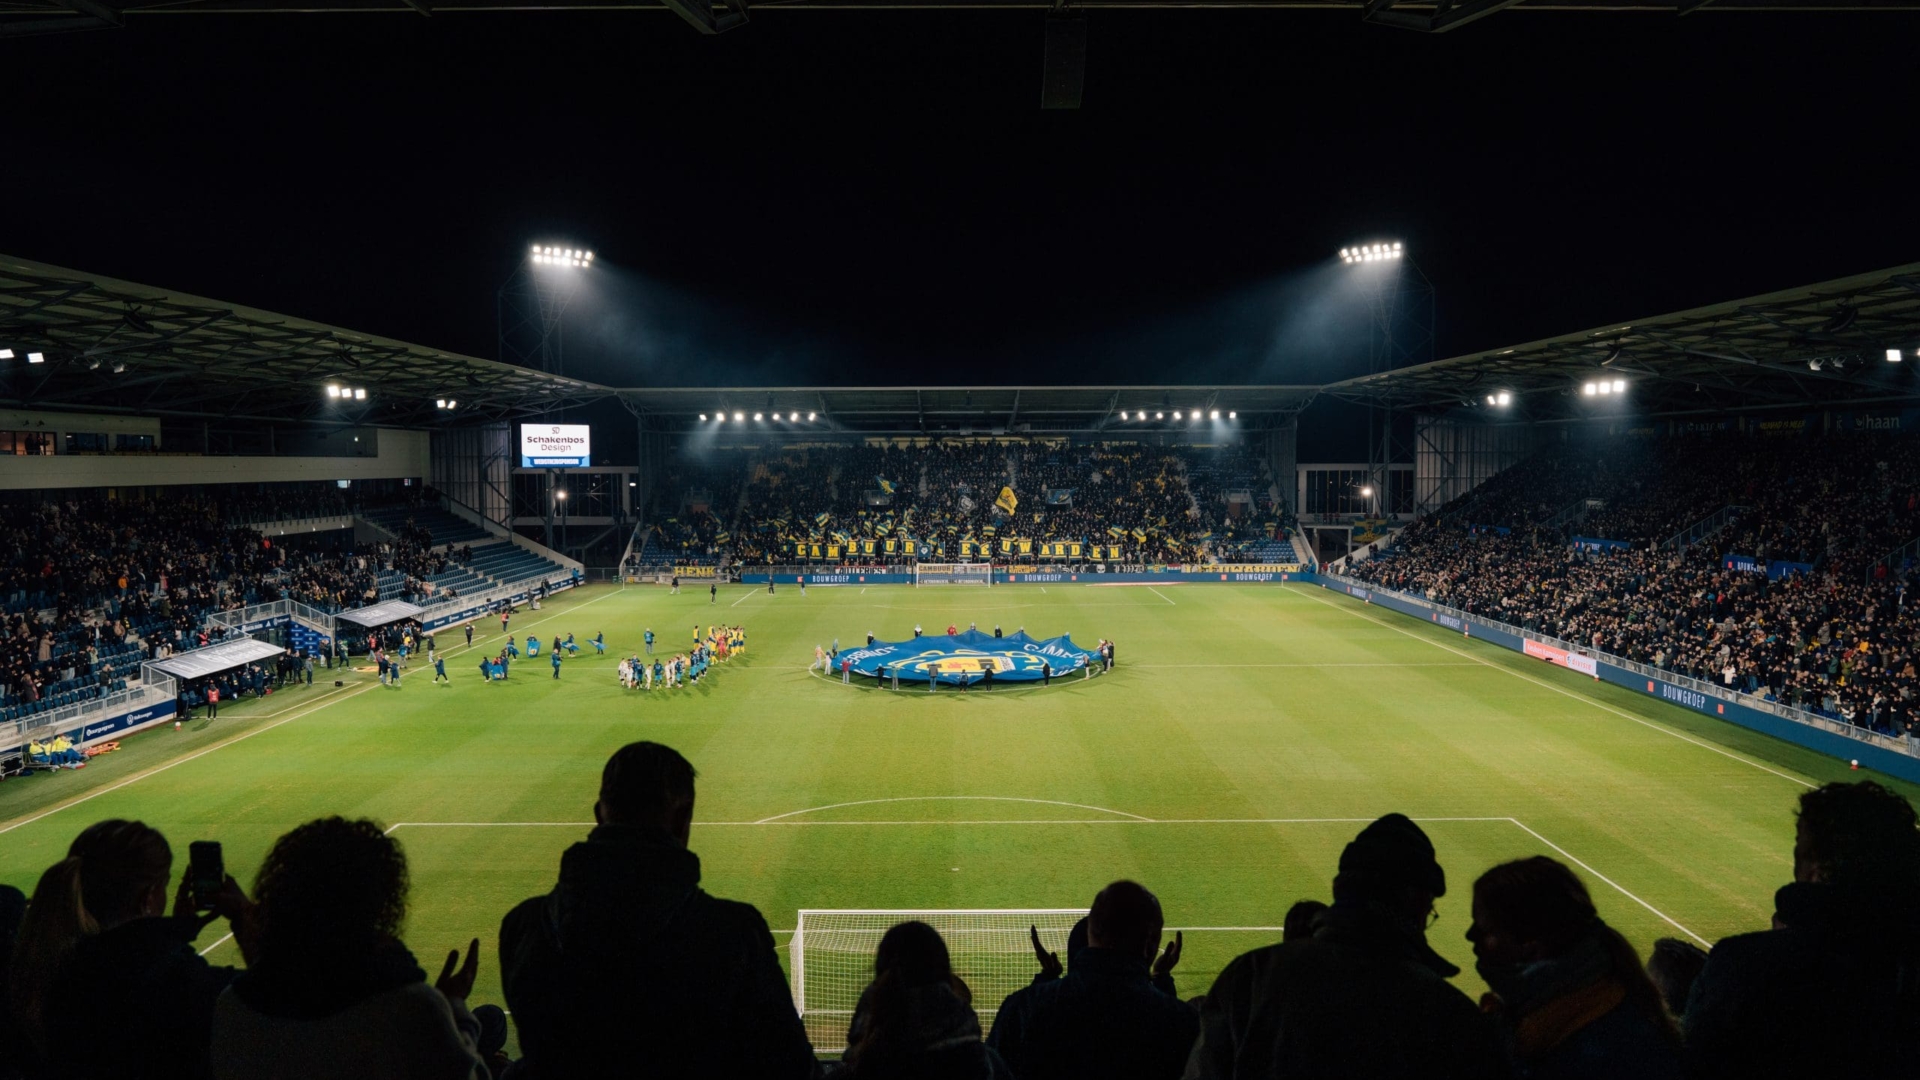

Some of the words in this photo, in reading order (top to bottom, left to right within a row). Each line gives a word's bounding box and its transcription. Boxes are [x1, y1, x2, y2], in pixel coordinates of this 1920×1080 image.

[527, 436, 585, 444] Schakenbos
[541, 444, 571, 453] Design
[674, 567, 715, 577] HENK
[812, 575, 850, 583] BOUWGROEP
[1024, 574, 1062, 582] BOUWGROEP
[1236, 573, 1273, 581] BOUWGROEP
[1663, 684, 1706, 709] BOUWGROEP
